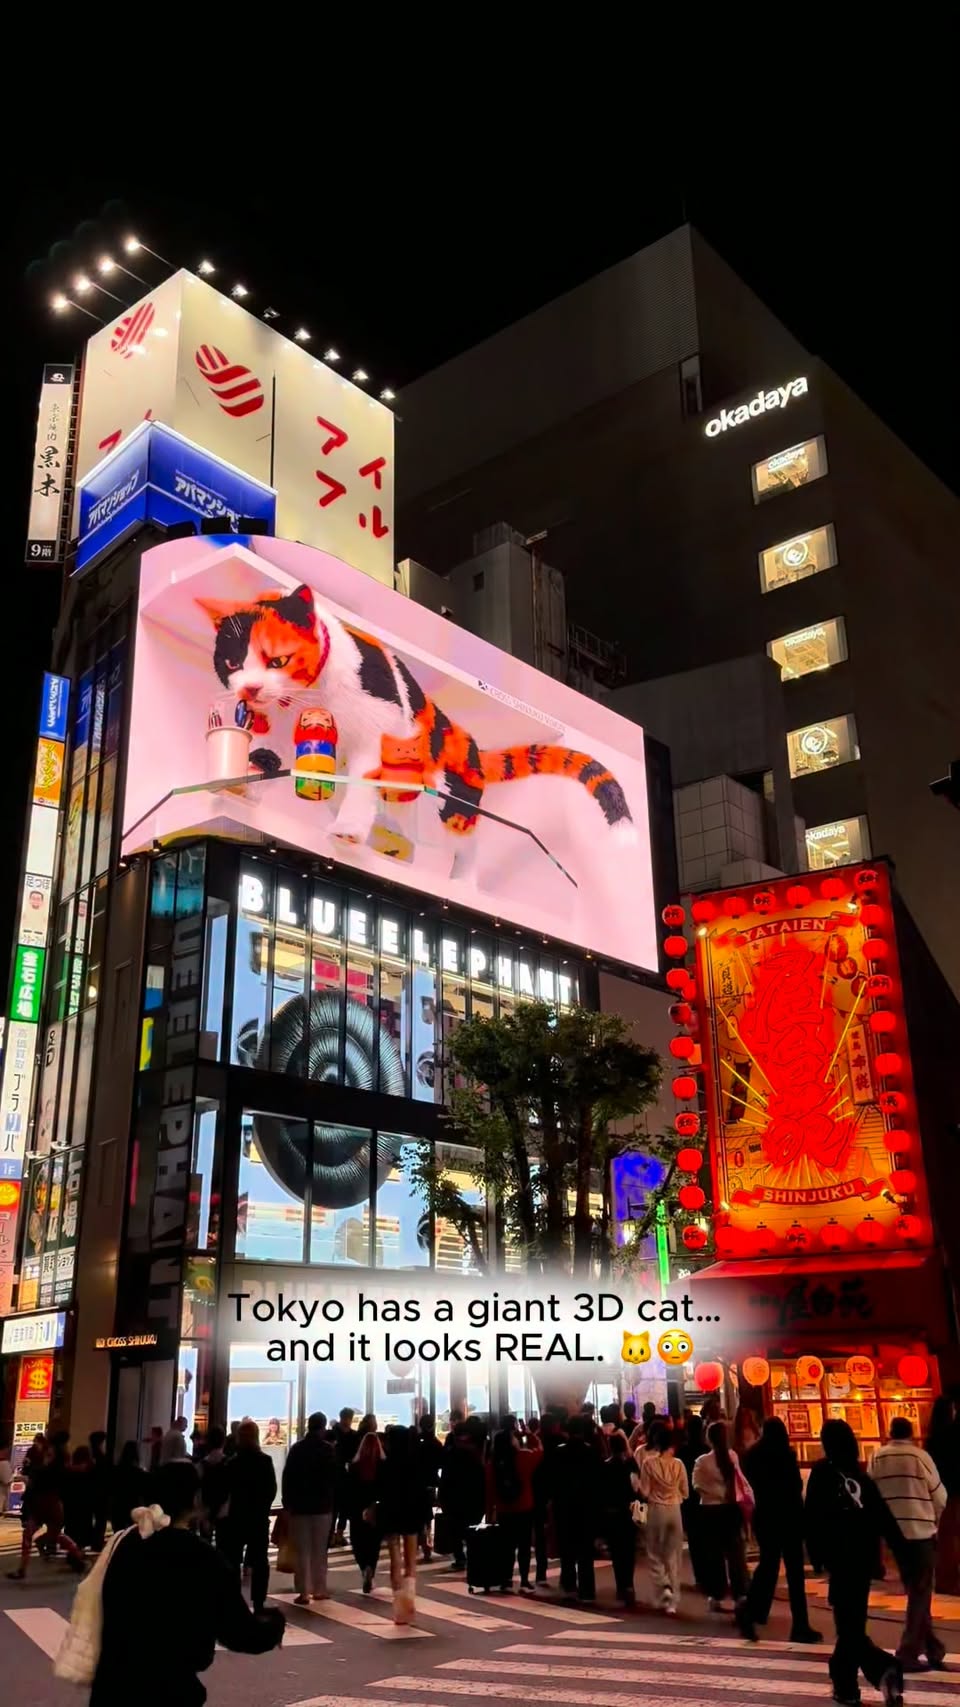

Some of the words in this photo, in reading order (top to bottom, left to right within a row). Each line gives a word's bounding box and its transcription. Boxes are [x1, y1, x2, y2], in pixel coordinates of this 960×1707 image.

[705, 376, 809, 437] okadaya
[742, 918, 827, 943] YATAIEN
[763, 1183, 856, 1203] SHINJUKU
